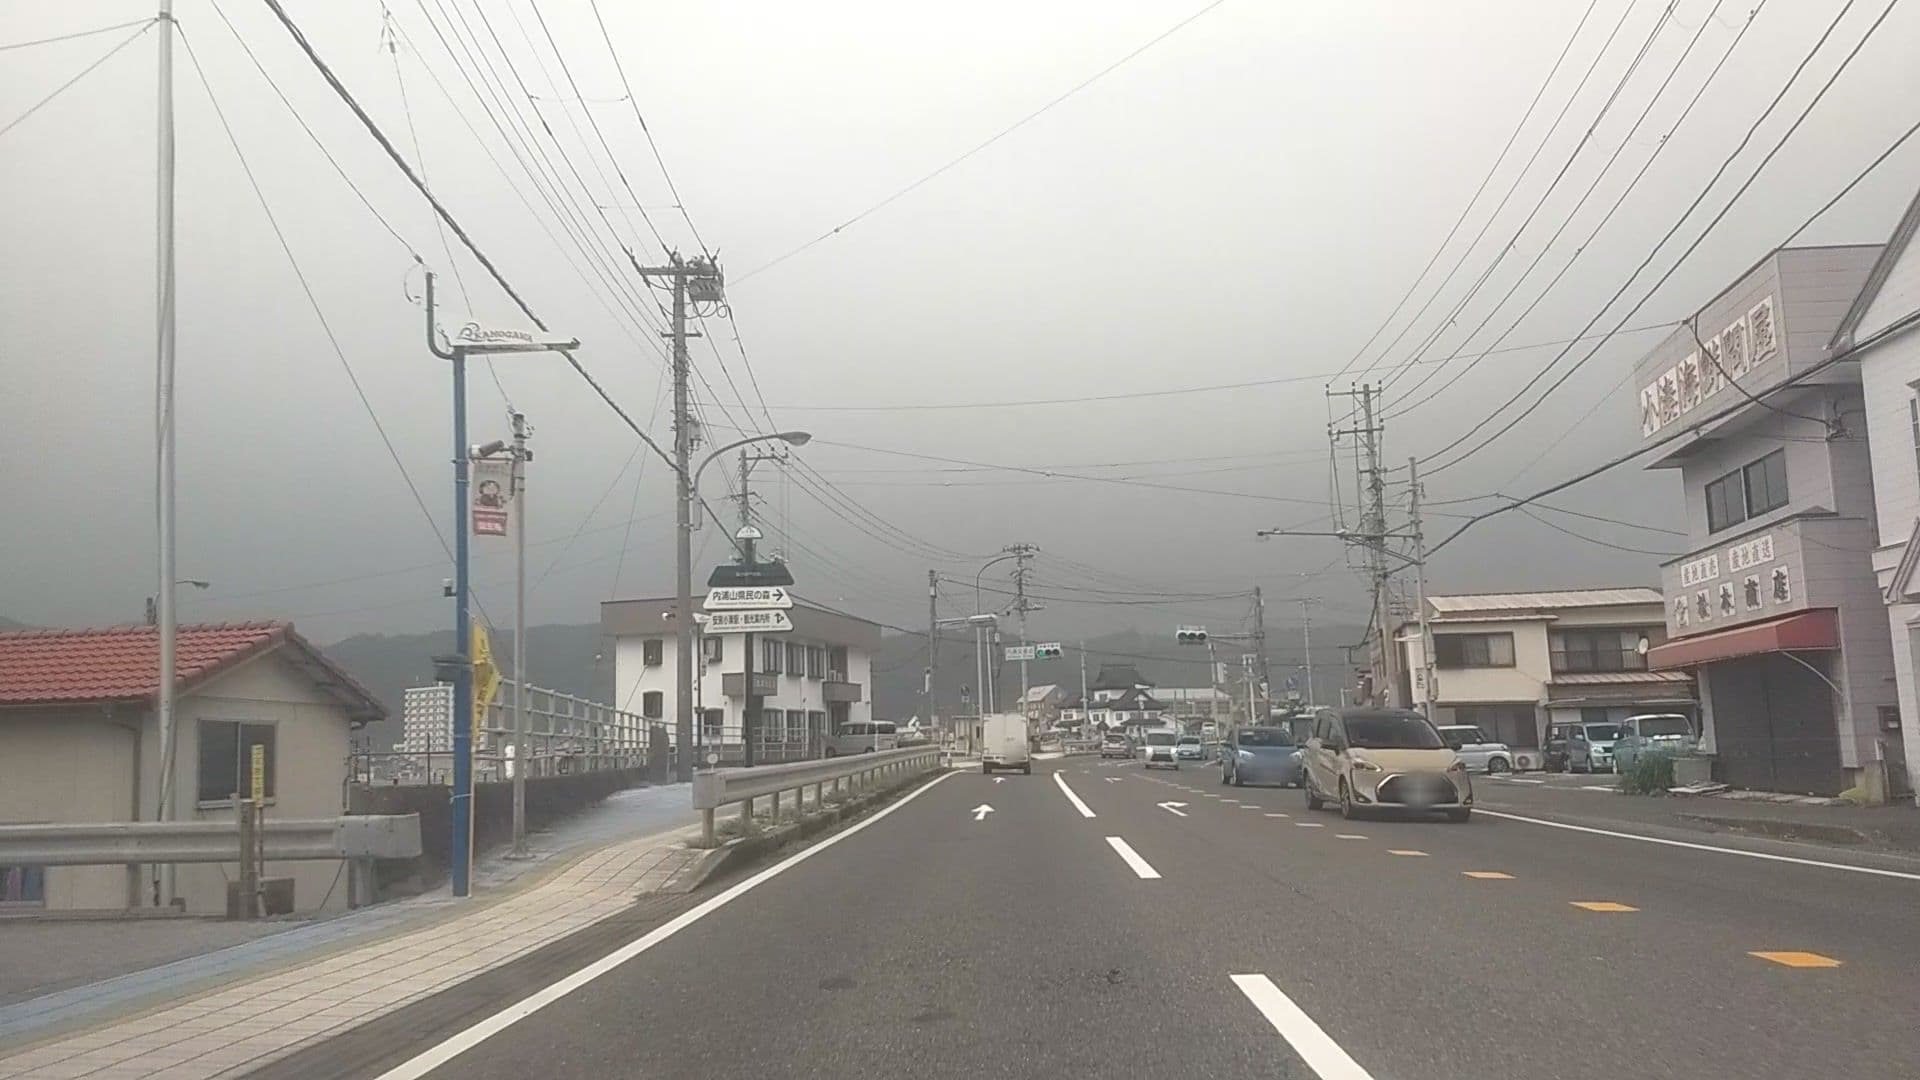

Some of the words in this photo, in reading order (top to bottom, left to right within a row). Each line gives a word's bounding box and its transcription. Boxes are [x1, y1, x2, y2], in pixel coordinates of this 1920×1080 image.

[712, 590, 770, 601] 内浦山県民の森
